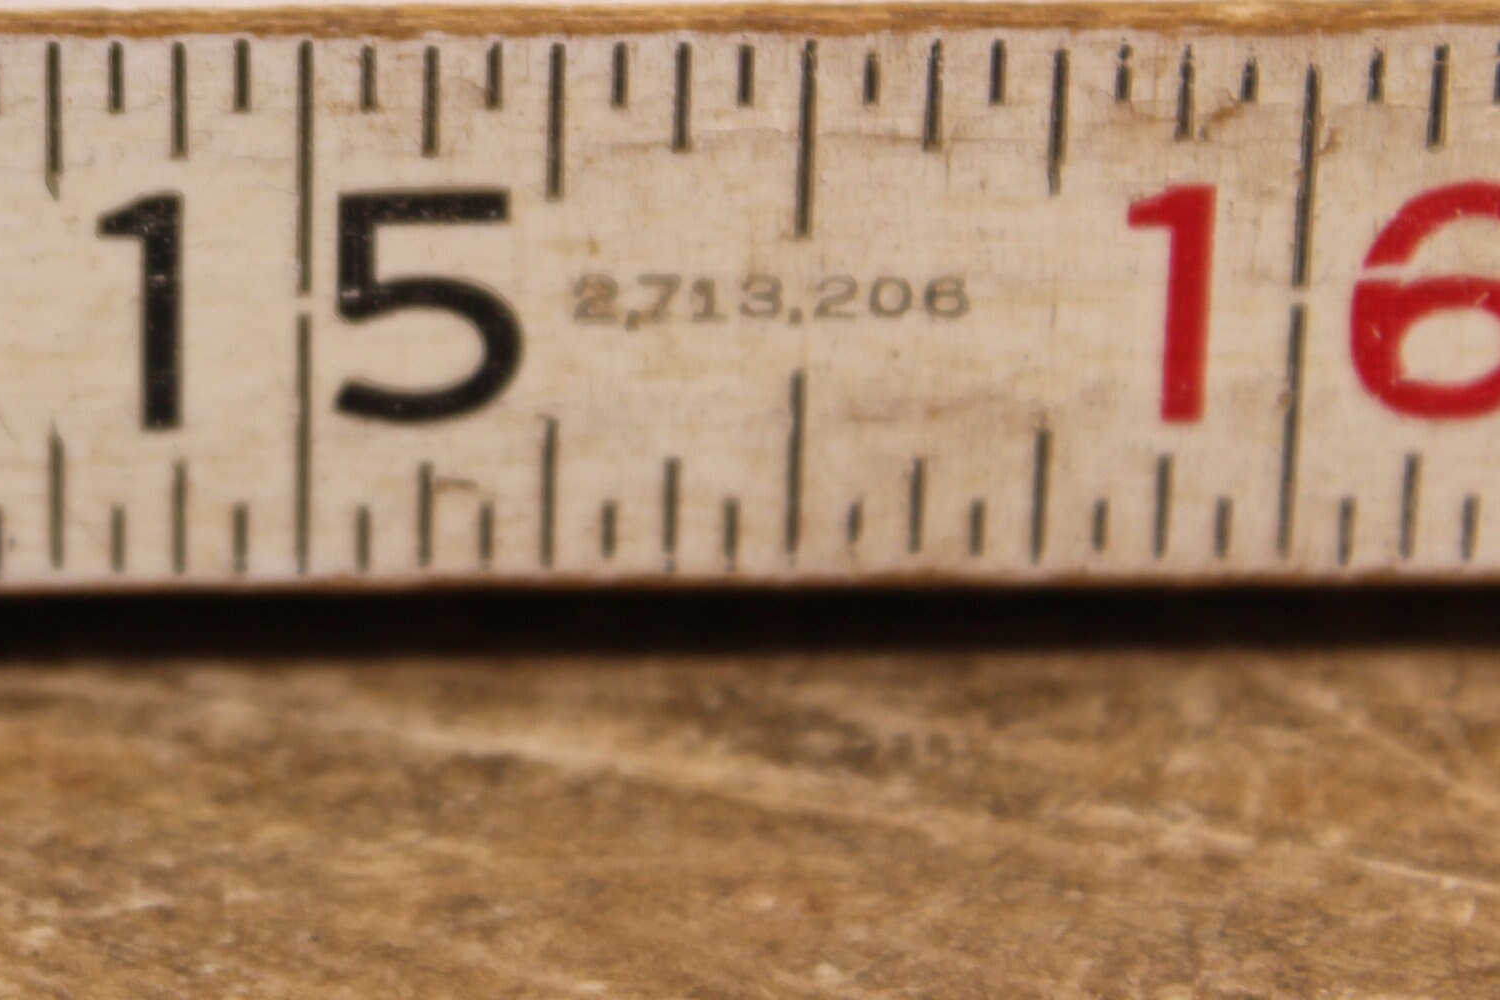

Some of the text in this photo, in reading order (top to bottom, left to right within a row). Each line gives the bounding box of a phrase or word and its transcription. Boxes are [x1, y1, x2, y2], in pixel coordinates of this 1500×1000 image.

[97, 186, 527, 431] 15
[572, 272, 971, 332] 2,713,206
[1125, 178, 1500, 425] 16
